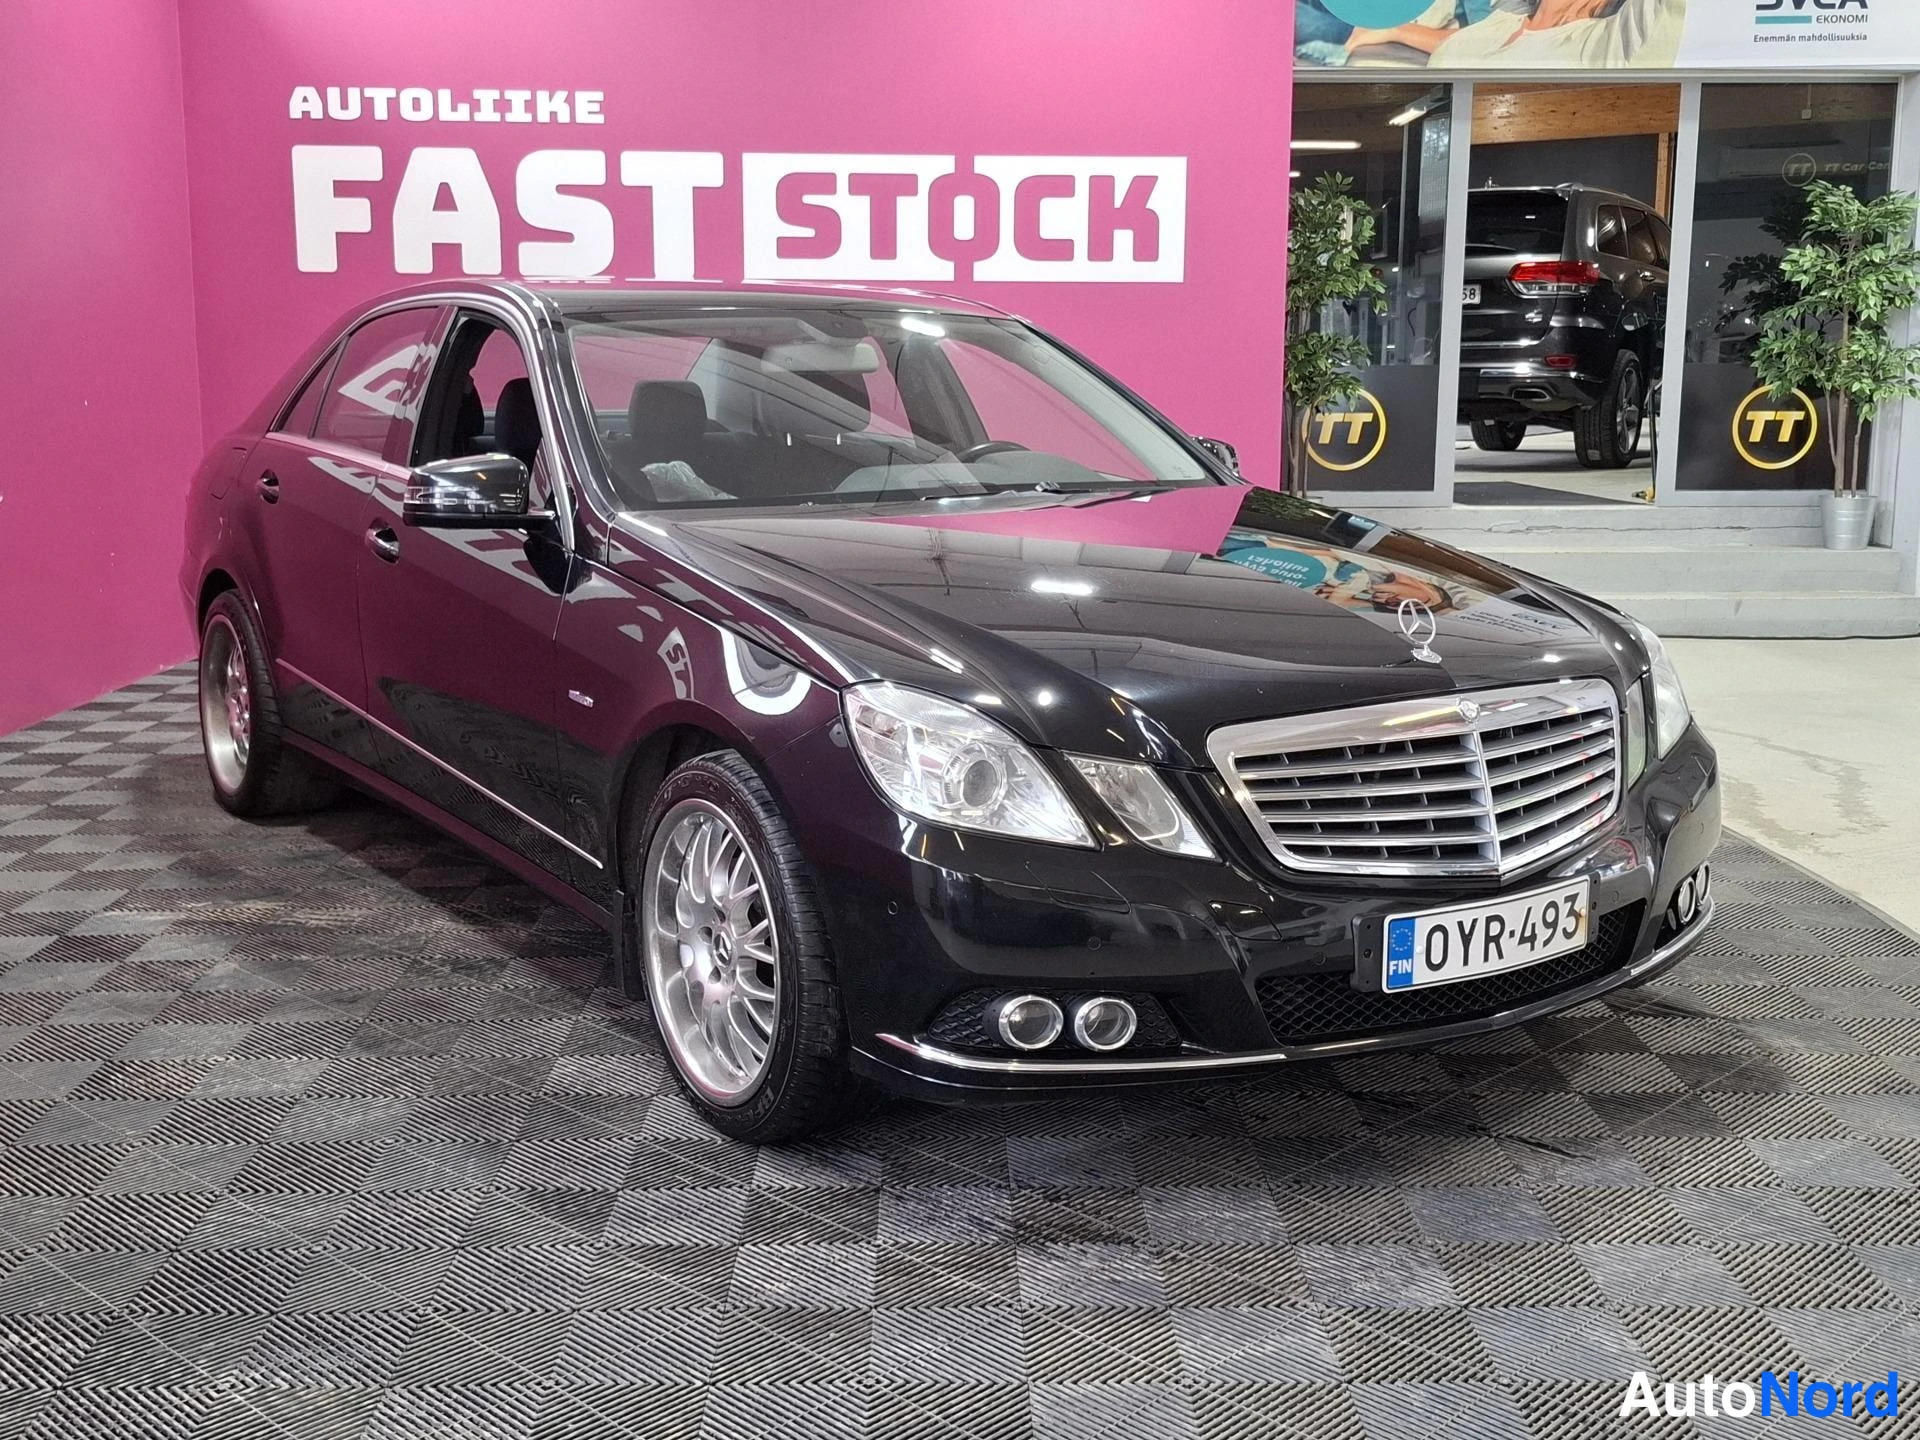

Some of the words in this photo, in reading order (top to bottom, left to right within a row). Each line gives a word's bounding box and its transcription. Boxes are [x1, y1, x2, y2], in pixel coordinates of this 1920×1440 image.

[1815, 14, 1868, 24] EKONOMI
[1753, 34, 1796, 43] Enemmän
[1798, 32, 1867, 42] mahdollisuuksia
[289, 86, 605, 124] AUTOLIIKE
[291, 144, 724, 280] FAST
[775, 171, 1160, 263] STOCK
[1315, 412, 1373, 444] TT
[1746, 411, 1805, 443] TT
[1425, 892, 1581, 971] OYR-493
[1388, 958, 1412, 976] FIN
